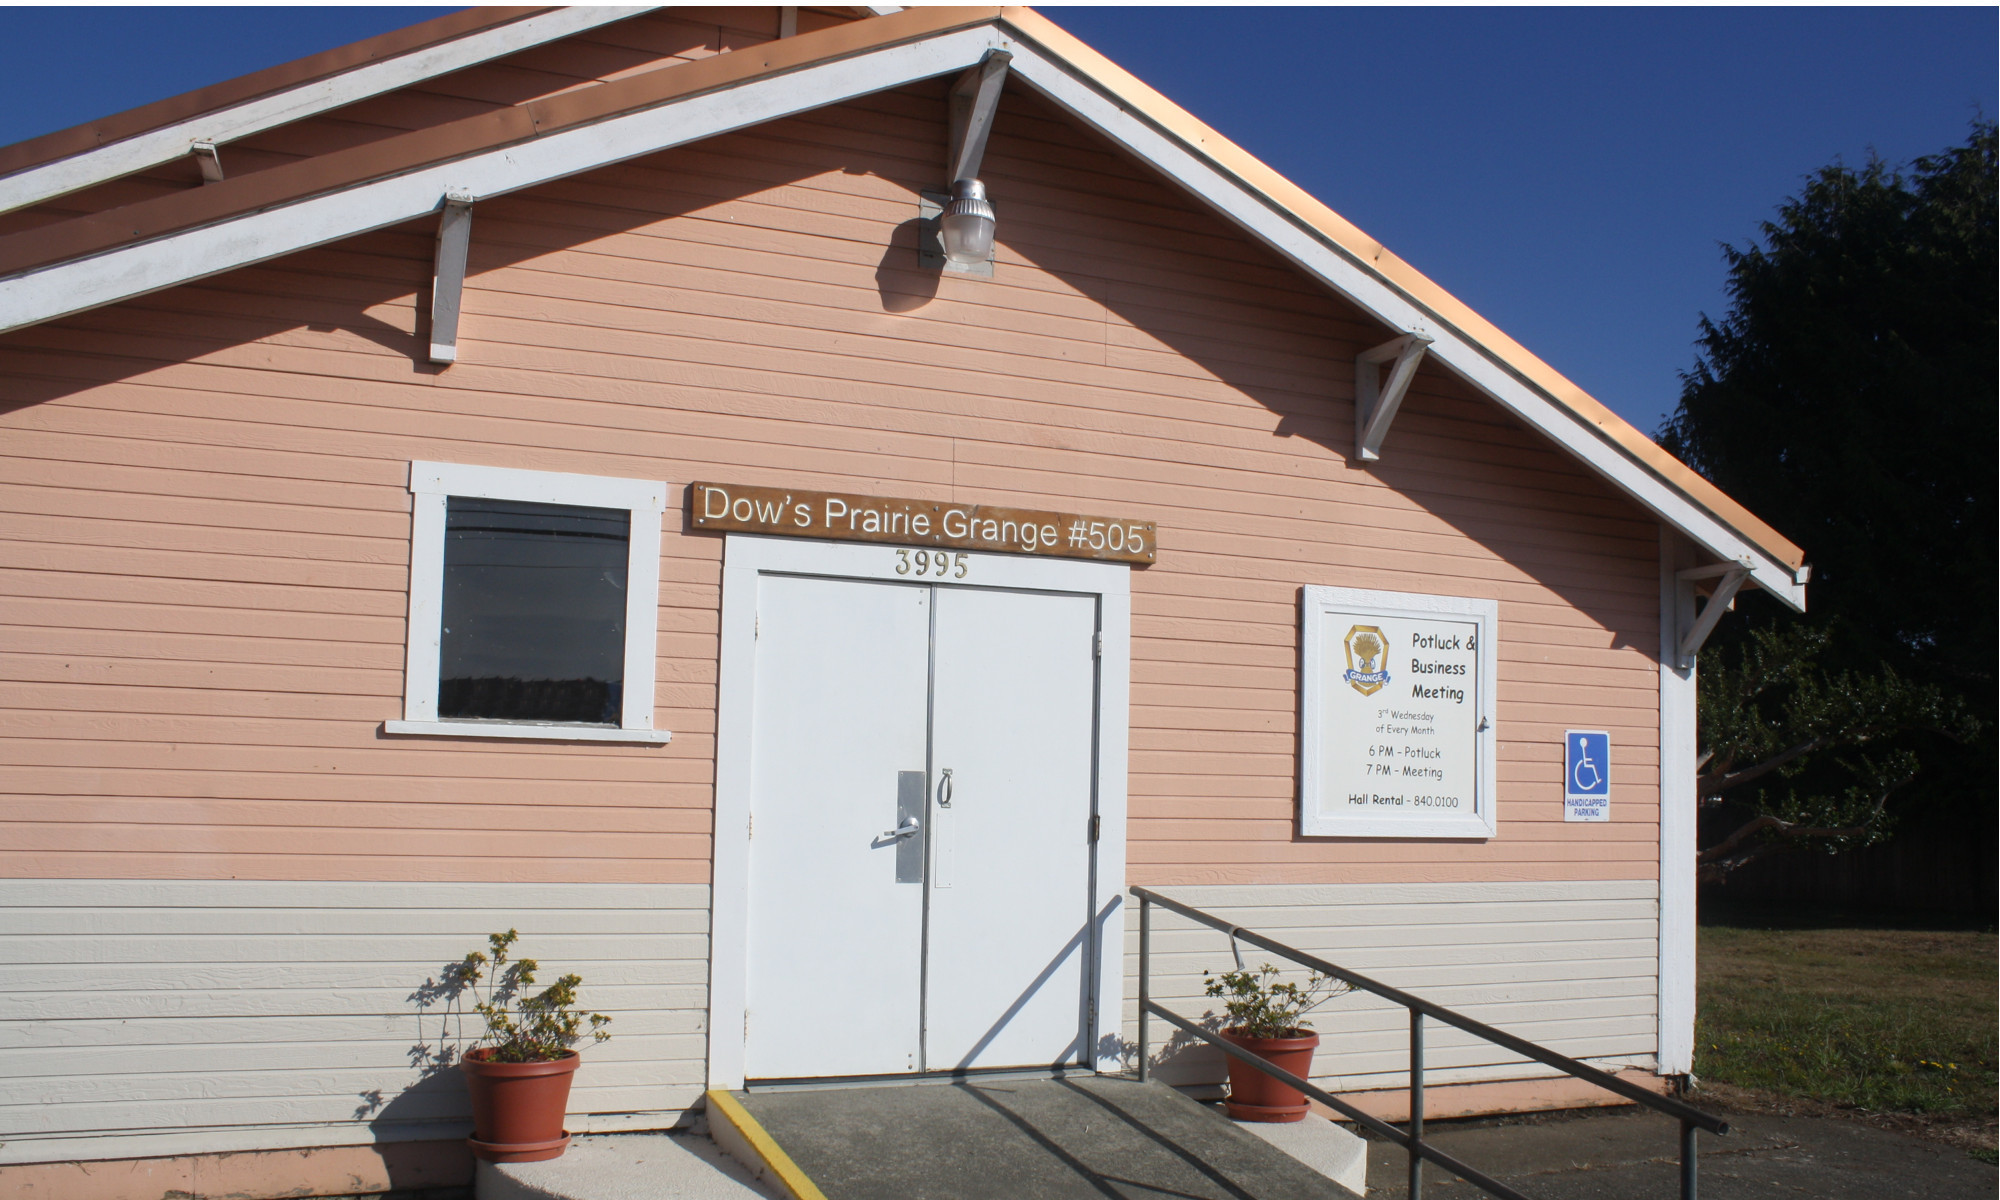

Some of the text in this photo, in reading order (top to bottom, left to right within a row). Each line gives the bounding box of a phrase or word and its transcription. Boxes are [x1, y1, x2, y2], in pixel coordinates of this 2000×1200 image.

[703, 486, 1145, 554] Dow's Prairie Grange #505
[895, 549, 969, 579] 3995
[1412, 632, 1476, 651] Potluck &
[1411, 659, 1466, 675] Business
[1350, 671, 1384, 682] GRANGE
[1412, 684, 1464, 703] Meeting
[1391, 710, 1434, 722] Wednesday
[1375, 723, 1435, 736] of Every Month
[1369, 745, 1375, 757] 6
[1378, 746, 1394, 758] PM
[1404, 747, 1441, 759] Potluck
[1366, 764, 1373, 776] 7
[1376, 765, 1392, 776] PM
[1402, 766, 1443, 780] Meeting
[1348, 794, 1369, 806] Hall
[1373, 795, 1404, 806] Rental
[1413, 796, 1459, 808] 840.0100
[1567, 798, 1607, 807] HANDICAPPED
[1574, 808, 1600, 816] PARKING
